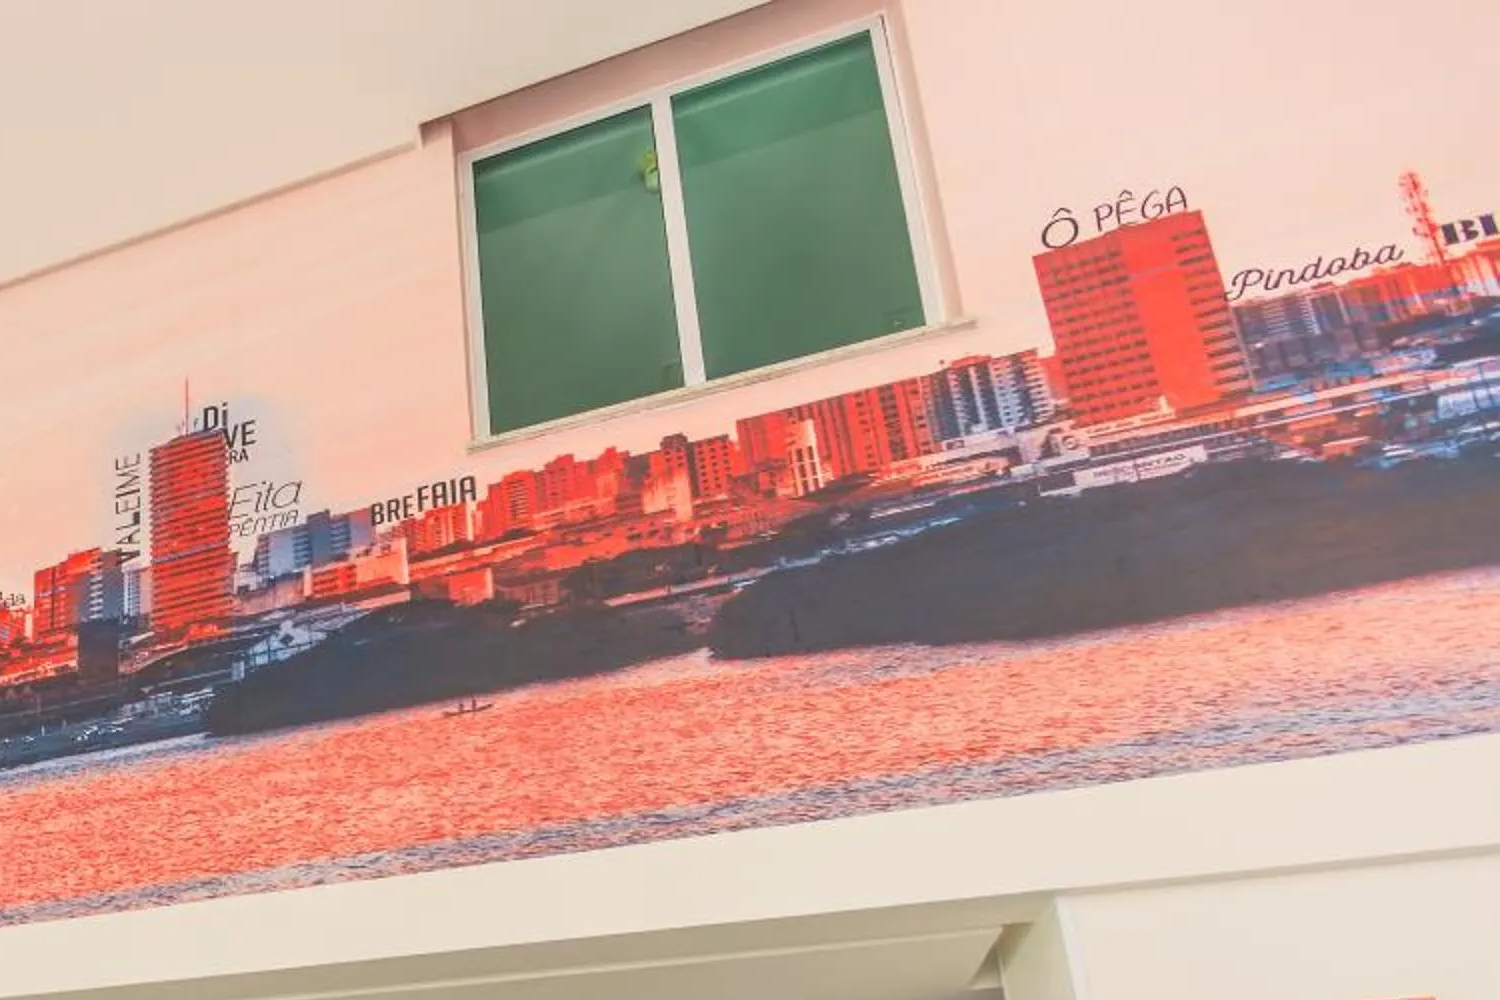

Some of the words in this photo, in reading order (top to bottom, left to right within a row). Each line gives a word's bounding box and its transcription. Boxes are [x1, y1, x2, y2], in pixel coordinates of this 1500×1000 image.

[1041, 207, 1079, 249] Ô
[1093, 185, 1189, 236] PÊGA
[1226, 242, 1405, 301] Pindoba
[371, 475, 478, 527] BREFAIA
